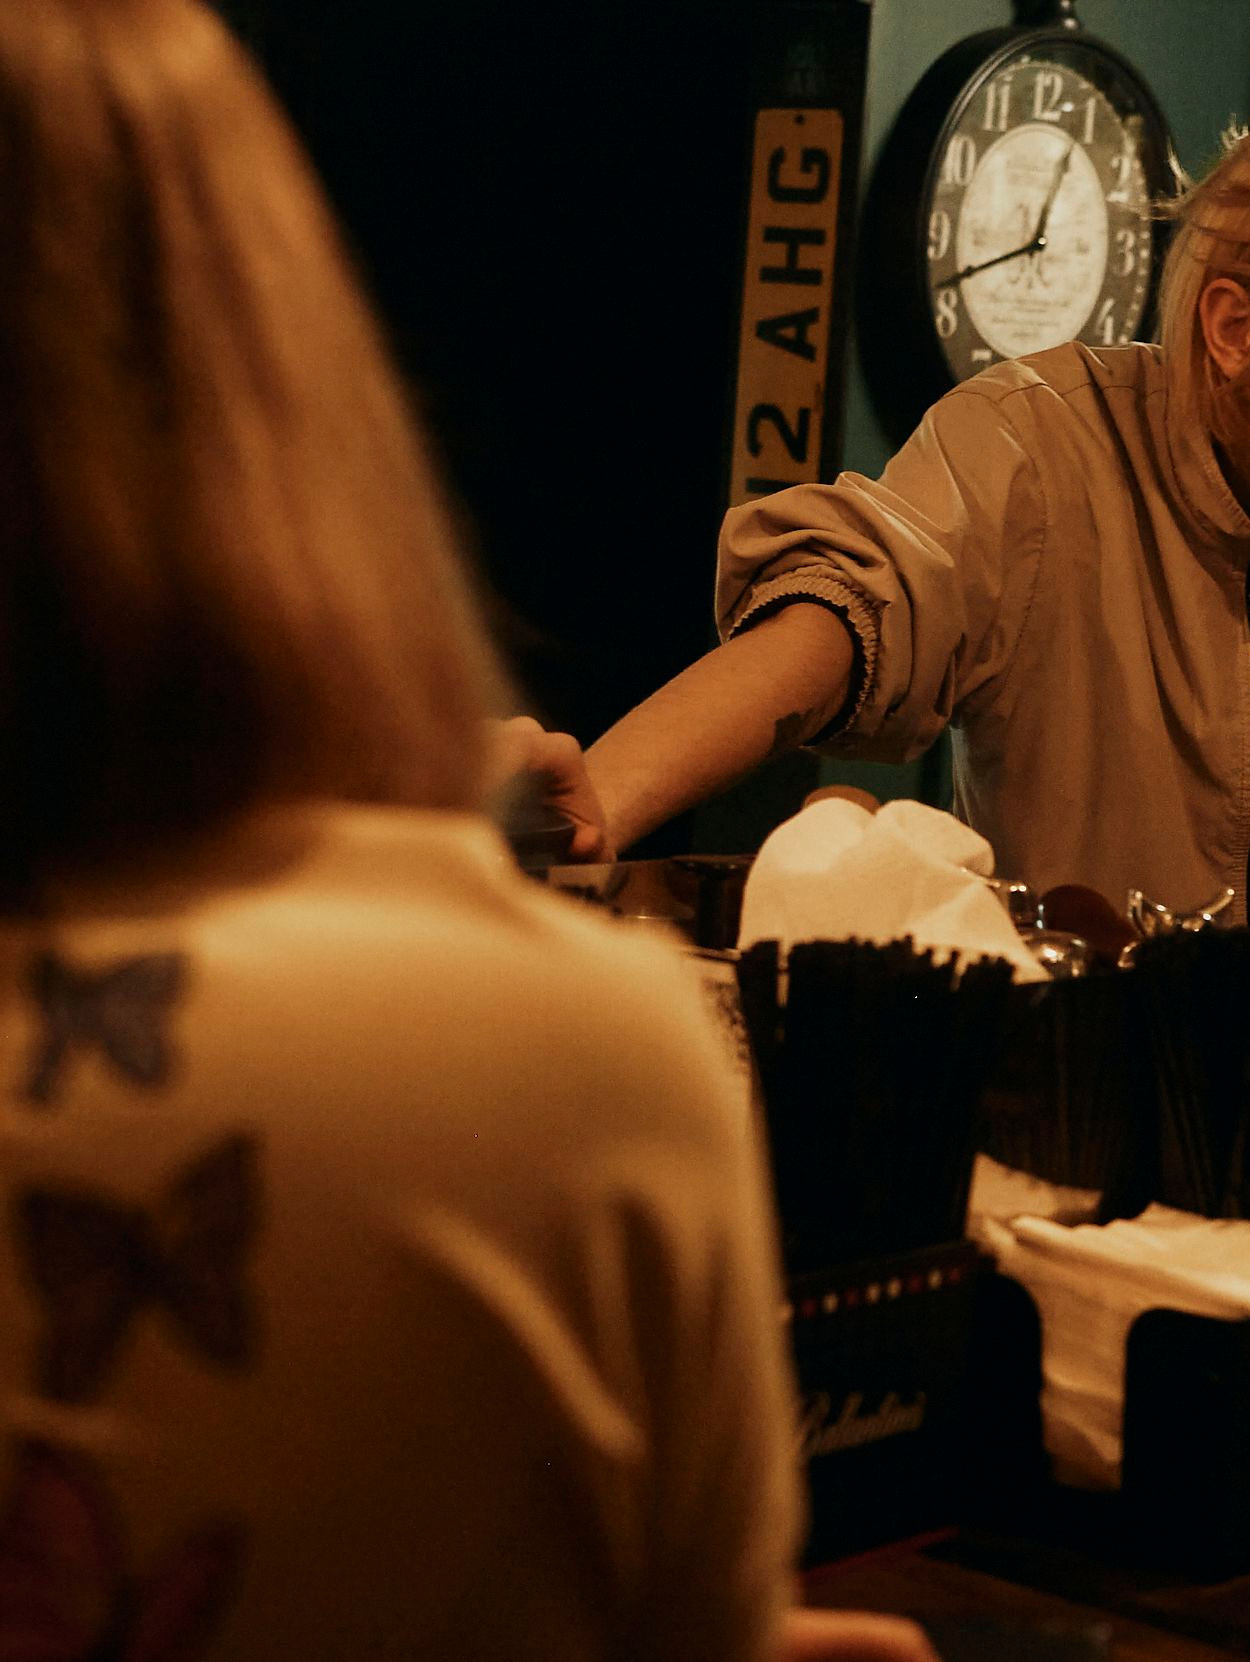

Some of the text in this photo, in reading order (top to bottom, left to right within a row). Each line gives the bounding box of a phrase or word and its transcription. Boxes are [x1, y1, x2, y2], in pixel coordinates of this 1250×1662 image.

[983, 80, 1011, 132] 11
[1032, 71, 1063, 121] 12
[1083, 97, 1097, 144] 1
[944, 135, 976, 187] 10
[1106, 156, 1131, 202] 2
[754, 146, 830, 364] AHG
[928, 210, 950, 260] 9
[1114, 230, 1136, 277] 3
[936, 289, 957, 337] 8
[1095, 298, 1115, 345] 4
